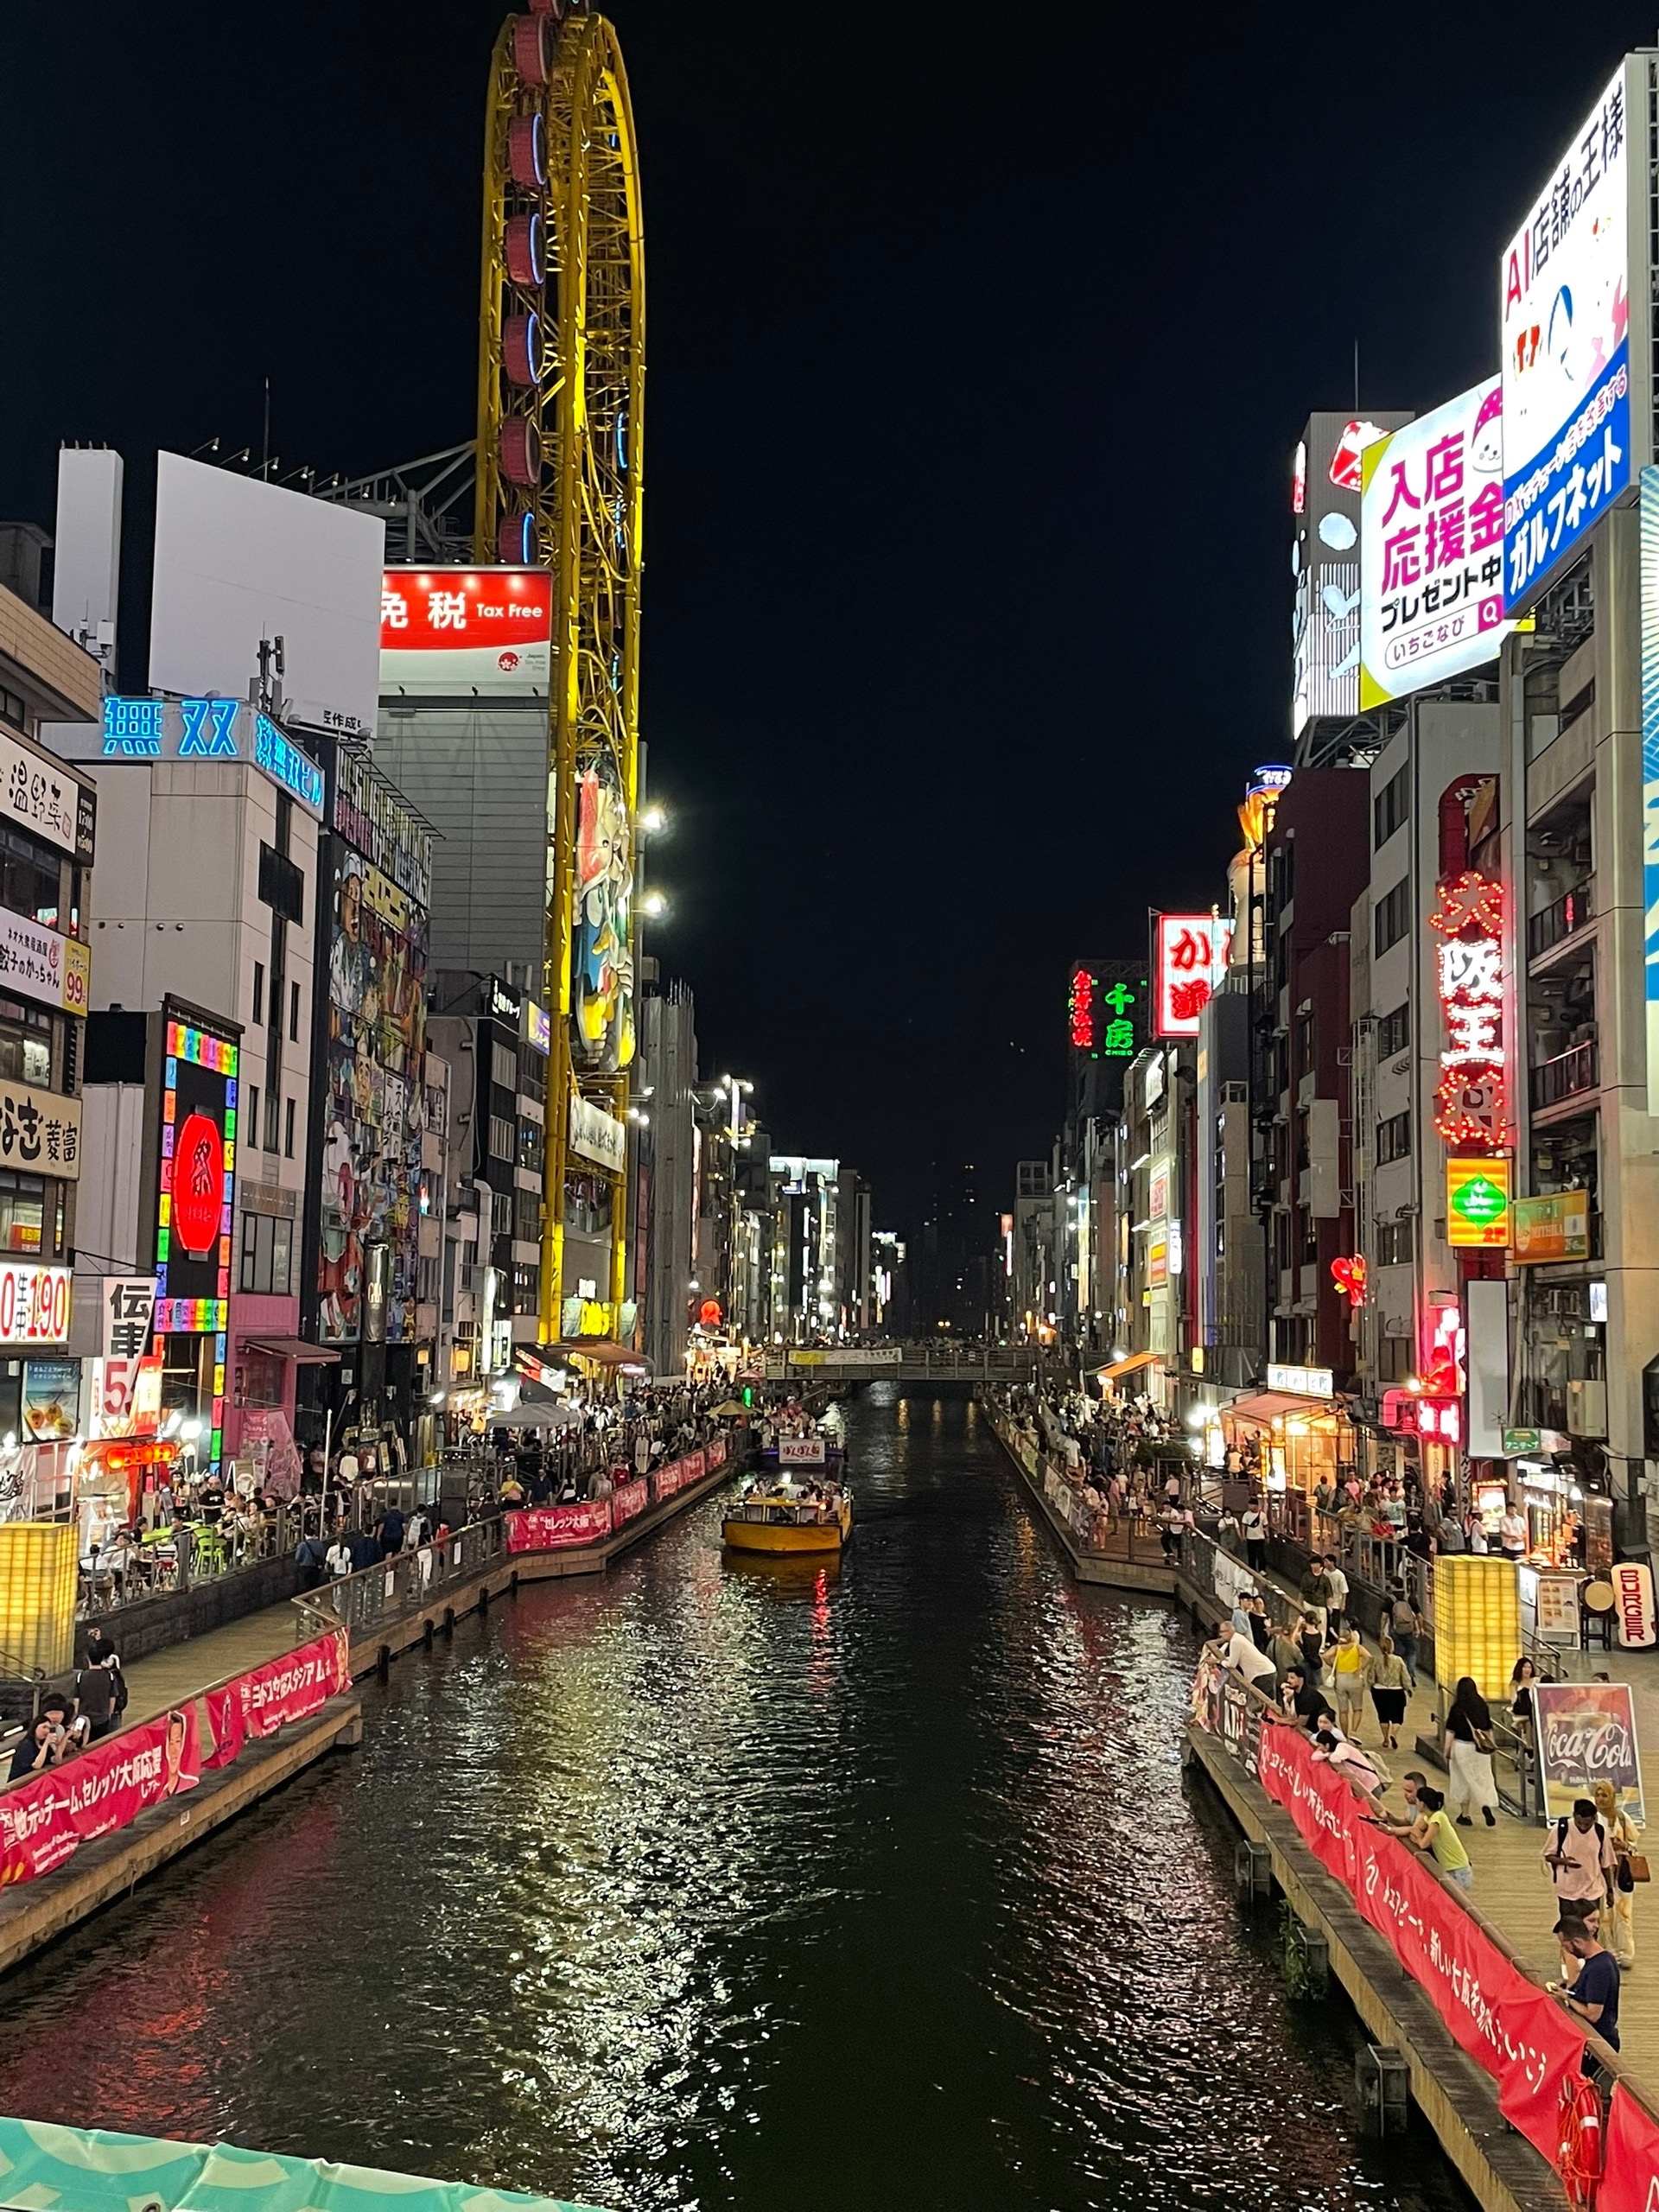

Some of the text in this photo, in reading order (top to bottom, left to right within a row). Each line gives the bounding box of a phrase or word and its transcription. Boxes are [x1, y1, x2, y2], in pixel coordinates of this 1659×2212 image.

[1506, 82, 1624, 321] AI店舗の王様
[1382, 430, 1465, 528] 入店
[1510, 424, 1623, 596] ガルフネット
[1382, 480, 1503, 597] 応援金
[381, 591, 543, 629] 免税 Tax Free
[1382, 553, 1503, 632] プレゼント中
[1391, 616, 1465, 662] いちごなび
[103, 696, 239, 756] 無双
[1104, 982, 1135, 1049] 千房
[1429, 870, 1507, 1147] 大阪王将
[1483, 1227, 1506, 1243] 2F
[1619, 1569, 1645, 1642] BURGER
[1546, 1721, 1633, 1770] Coca-Cola
